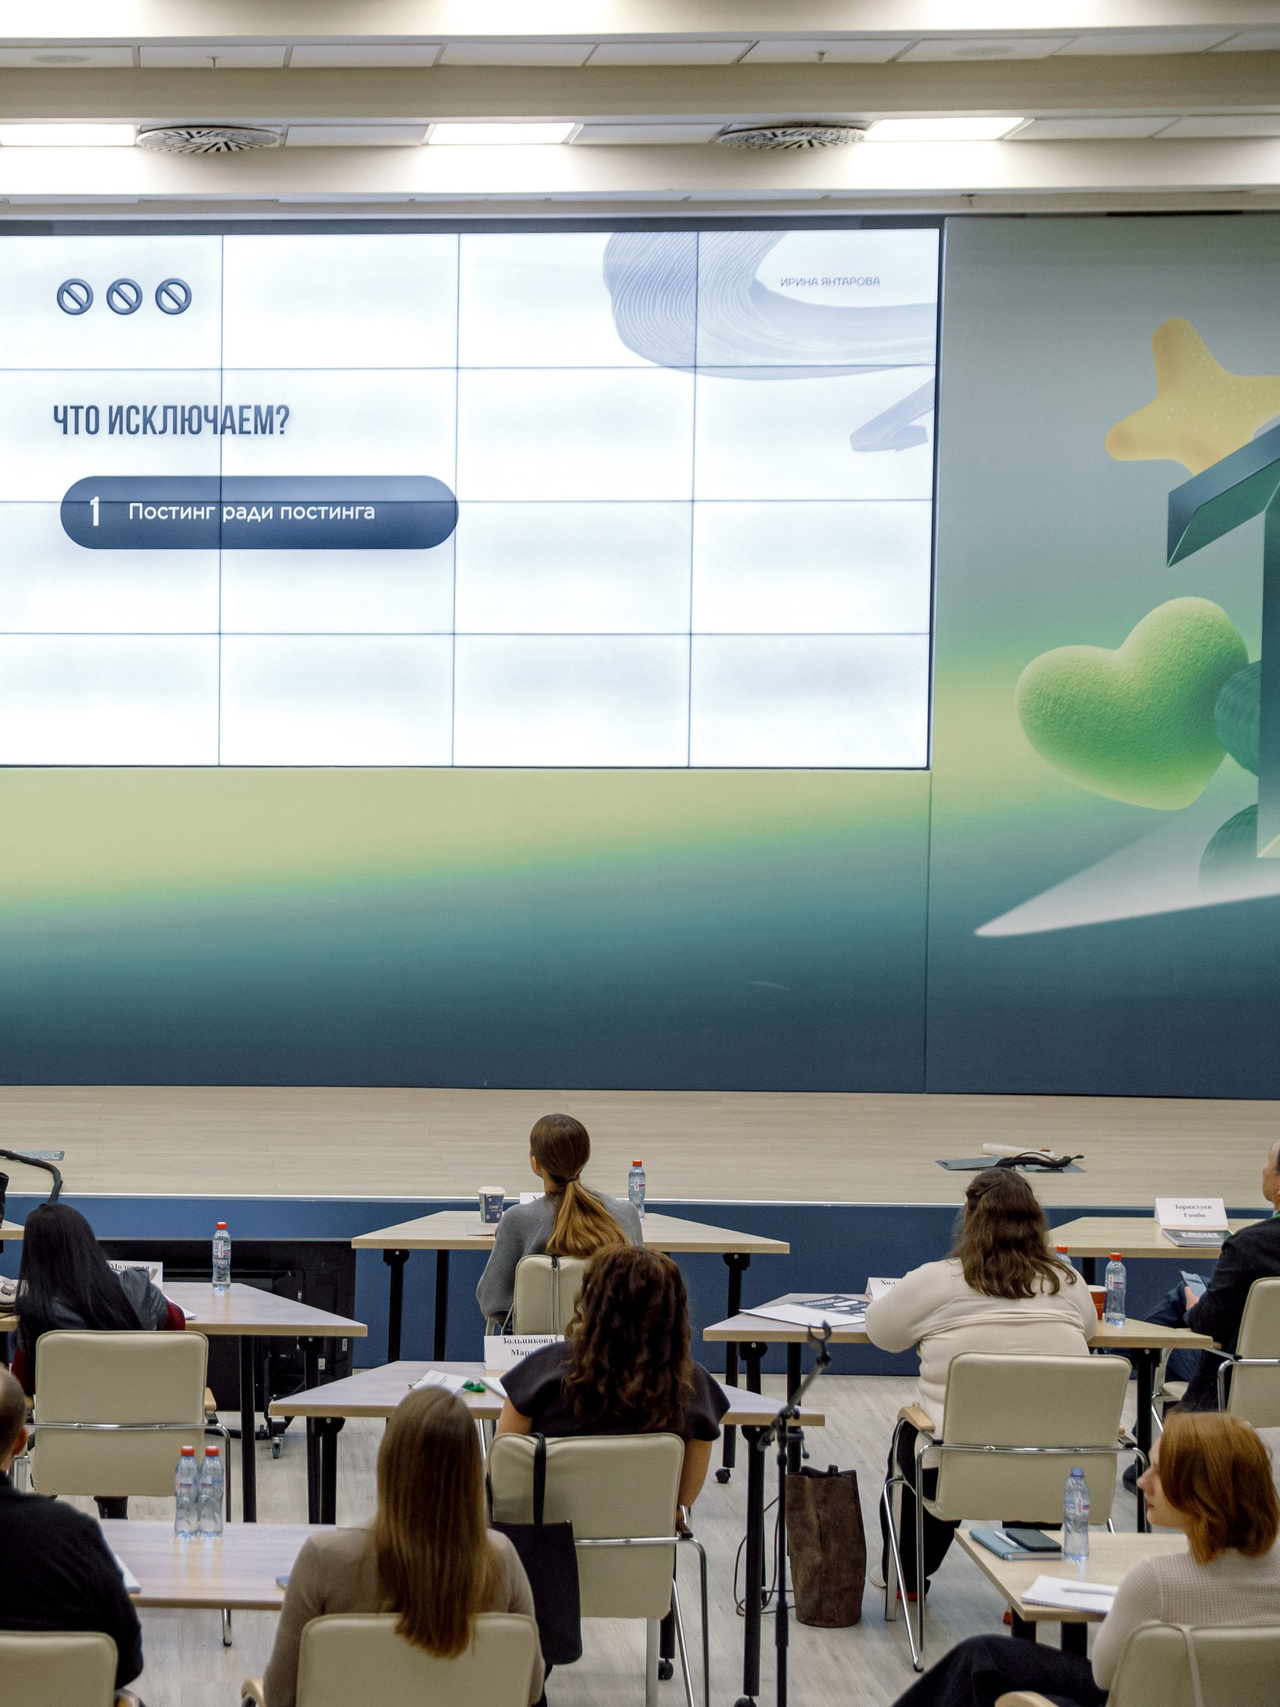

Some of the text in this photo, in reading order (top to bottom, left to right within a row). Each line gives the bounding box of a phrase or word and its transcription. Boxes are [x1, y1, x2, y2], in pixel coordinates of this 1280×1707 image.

[780, 276, 881, 287] ИРИНА ЯНТАРОВА
[53, 404, 291, 435] ЧТО ИСКЛЮЧАЕМ?
[89, 495, 376, 527] 1 Постинг ради постинга
